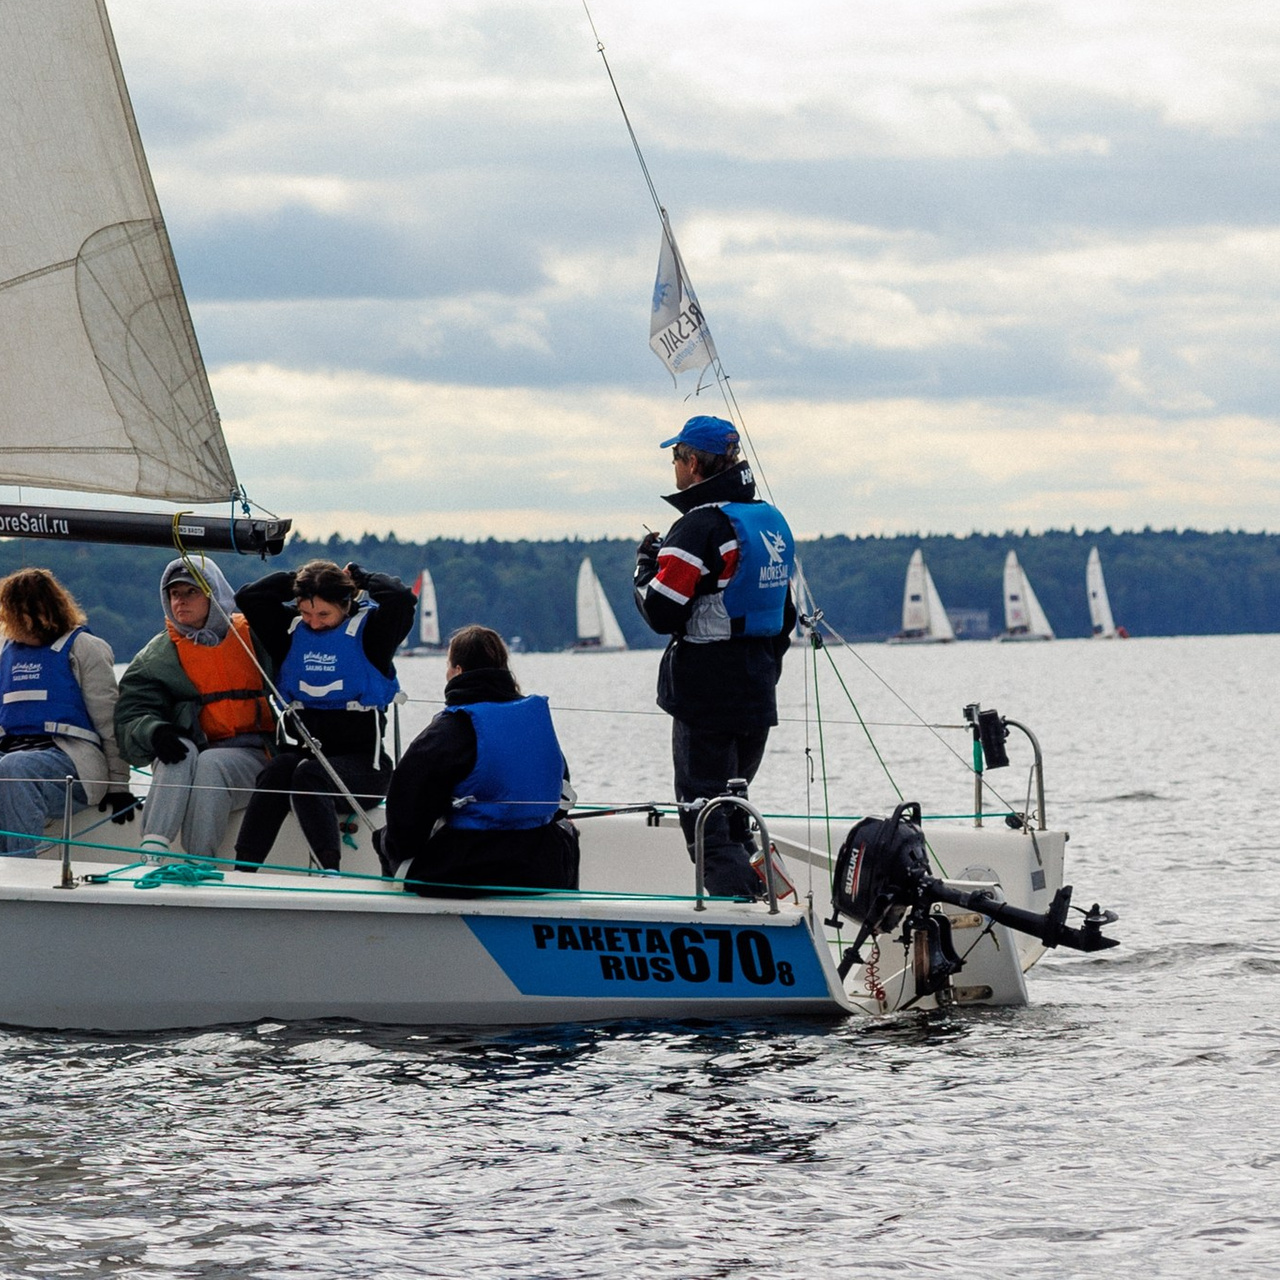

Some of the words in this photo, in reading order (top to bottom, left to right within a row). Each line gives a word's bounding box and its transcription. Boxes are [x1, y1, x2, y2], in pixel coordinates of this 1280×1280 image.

[844, 847, 860, 895] SUZUKI
[599, 954, 675, 983] RUS
[669, 926, 777, 986] 670
